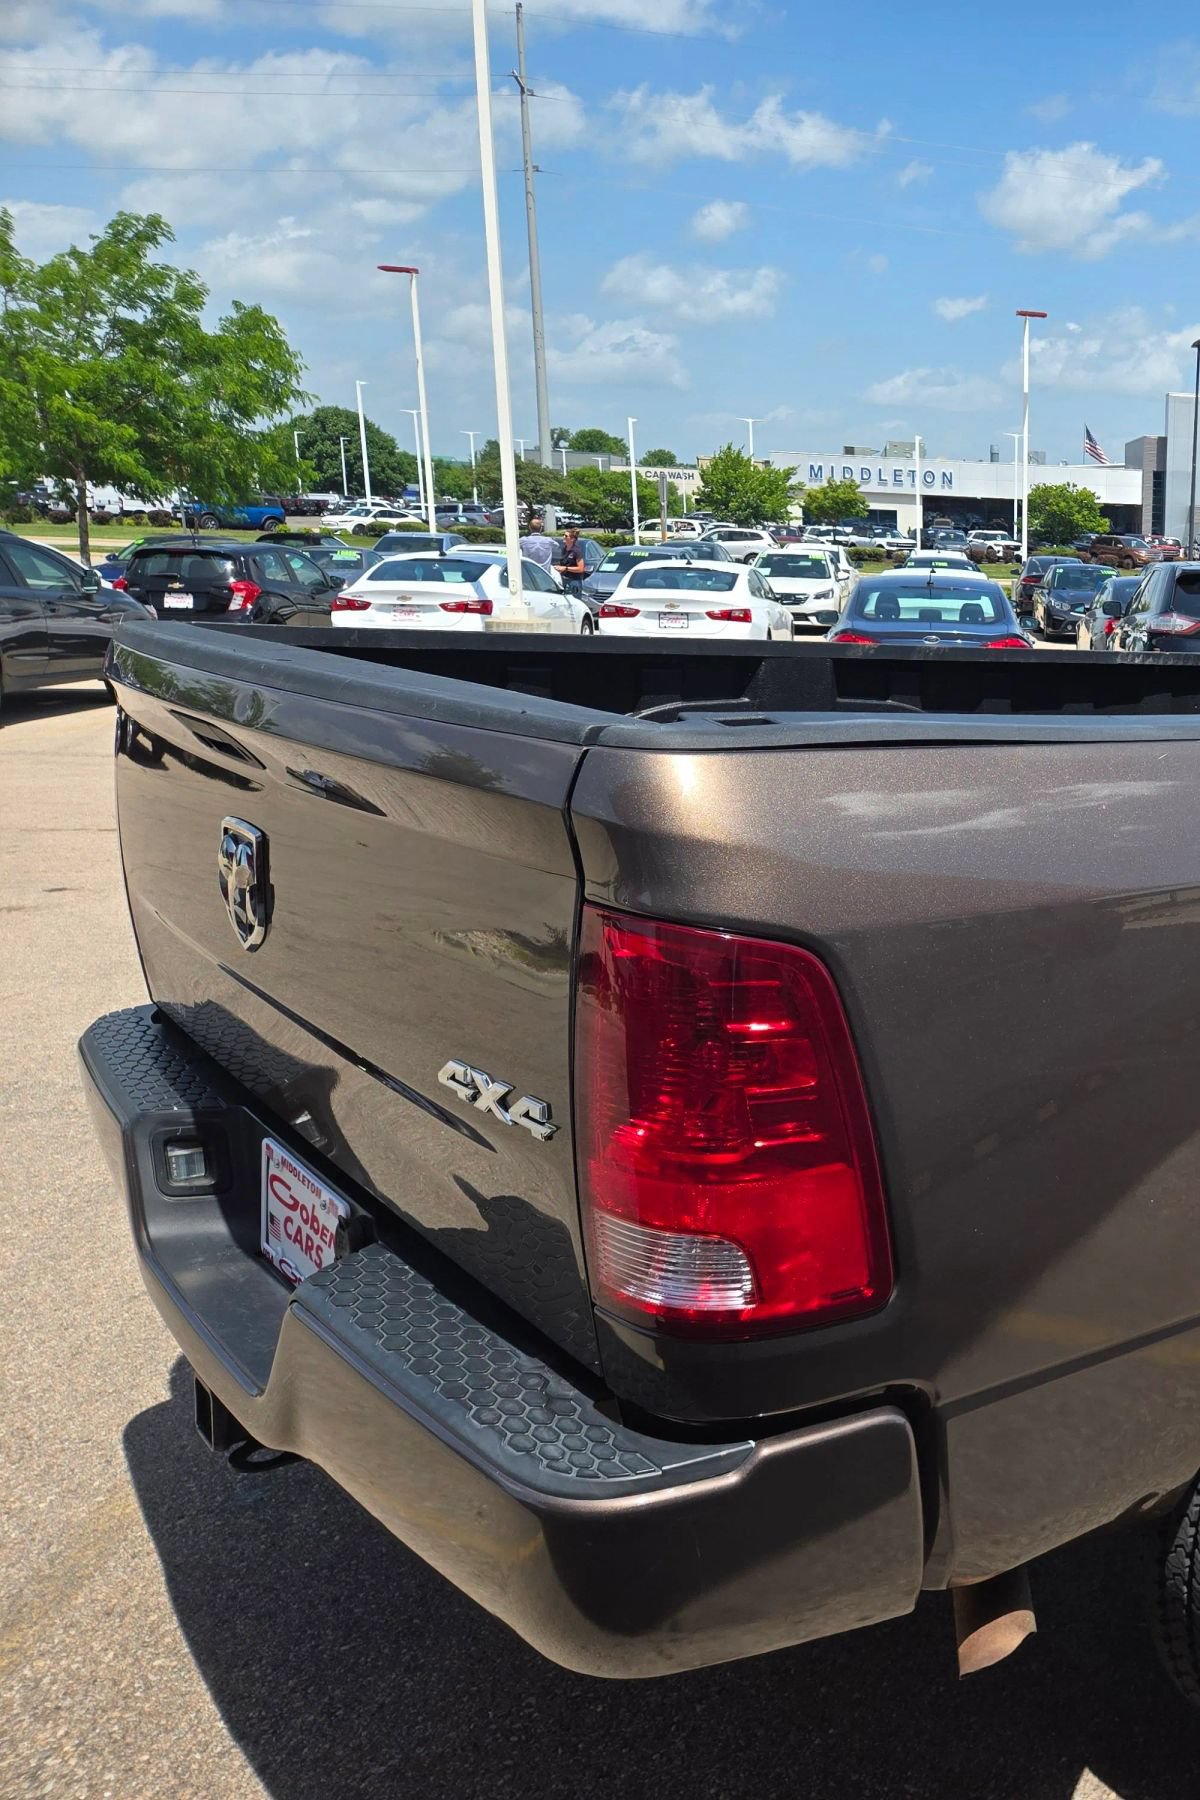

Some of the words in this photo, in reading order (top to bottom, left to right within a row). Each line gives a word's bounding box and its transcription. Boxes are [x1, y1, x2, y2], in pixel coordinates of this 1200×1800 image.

[667, 471, 695, 480] WASH
[808, 463, 954, 486] MIDDLETON
[280, 1155, 322, 1199] MIDDLETON
[283, 1215, 323, 1271] CARS
